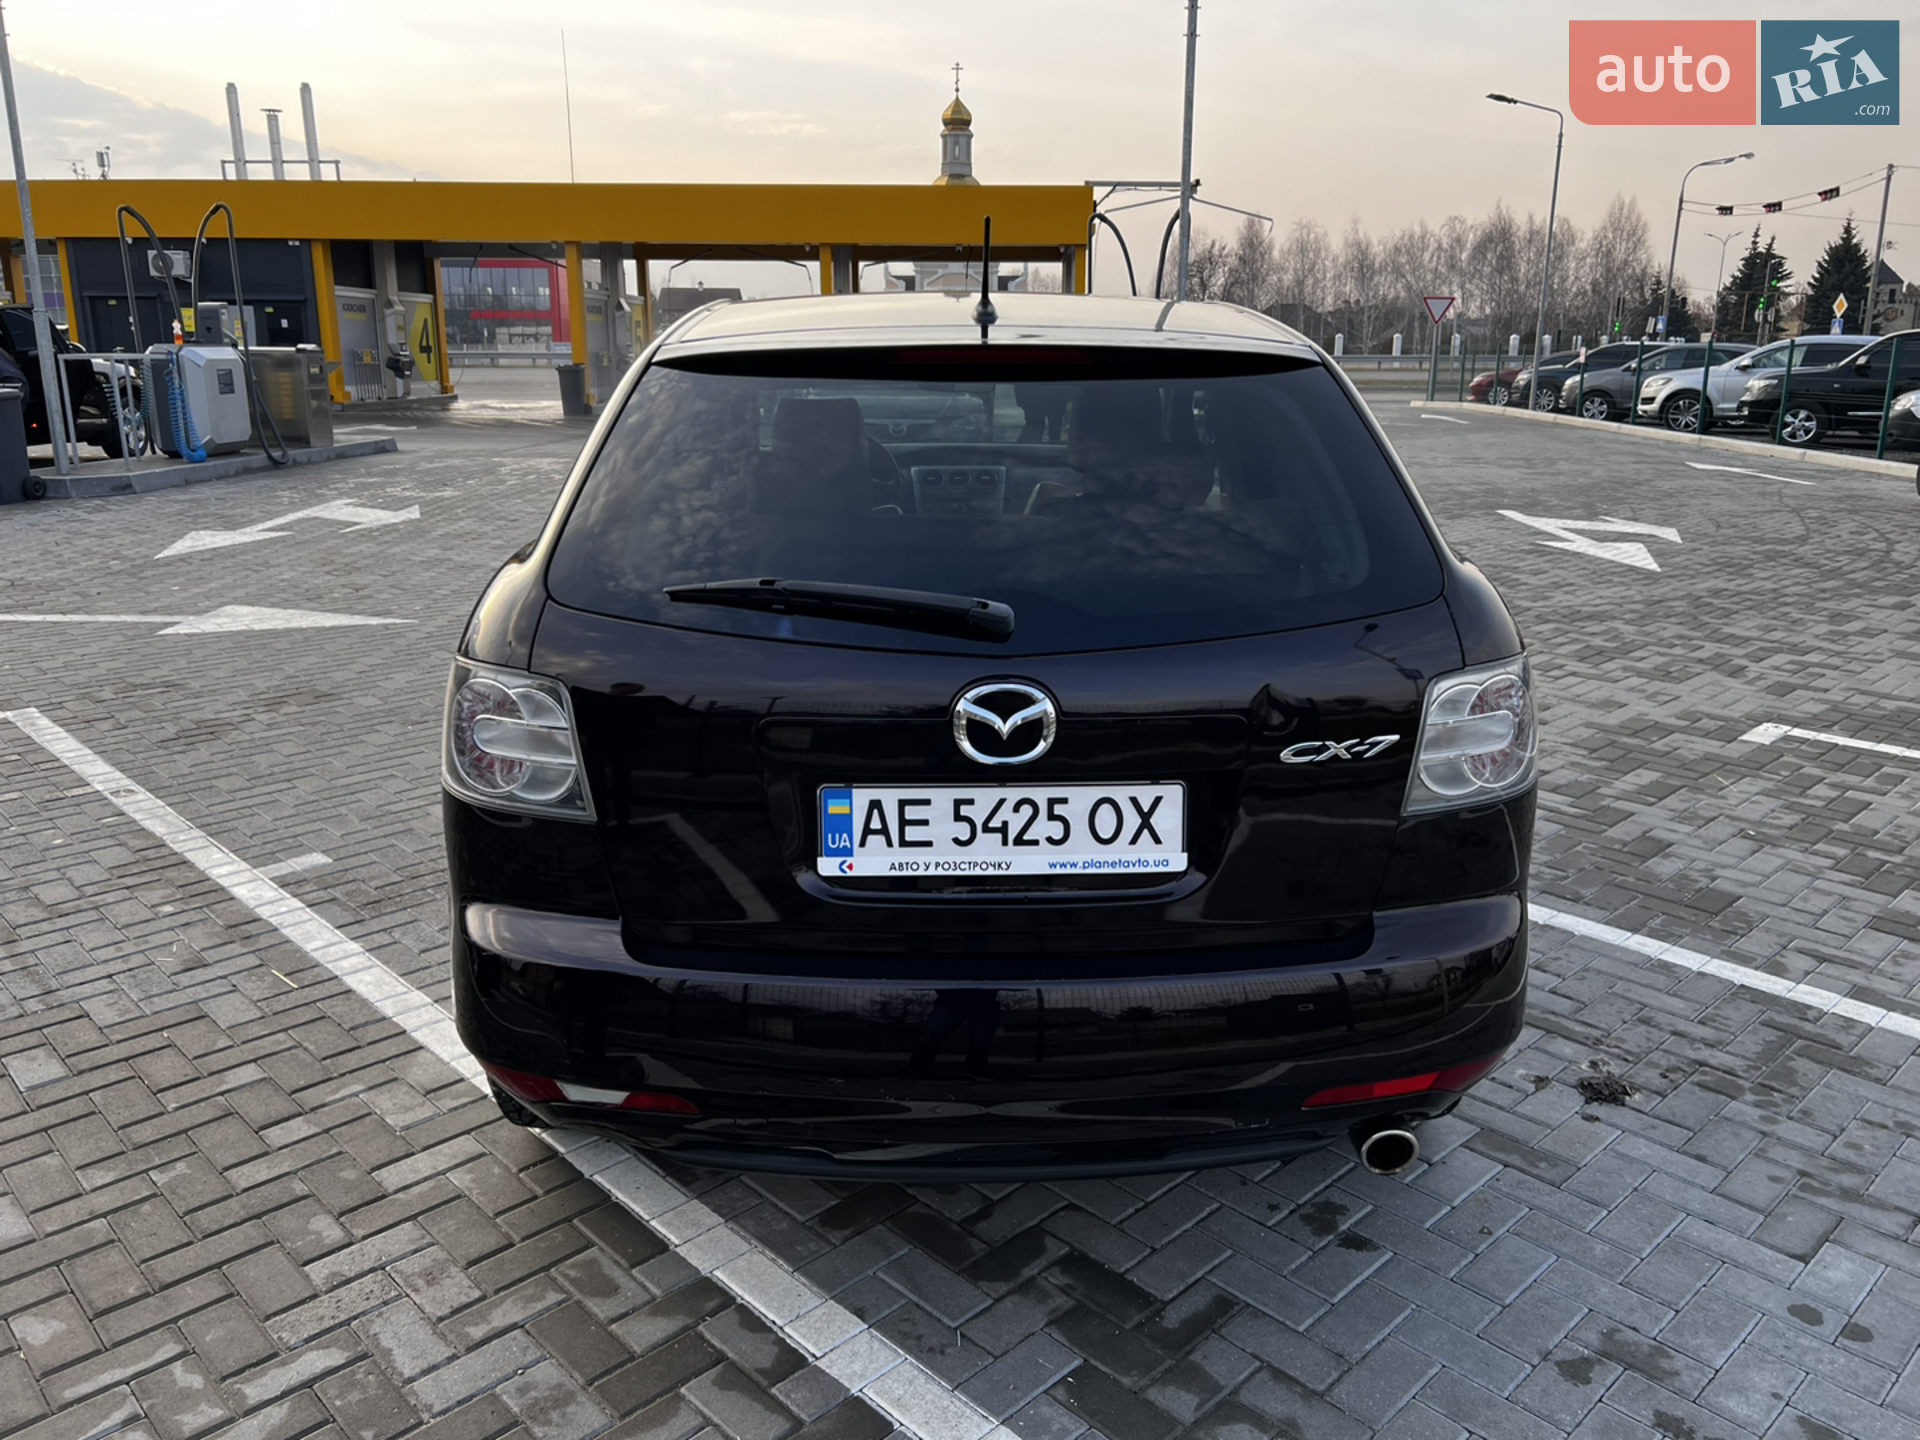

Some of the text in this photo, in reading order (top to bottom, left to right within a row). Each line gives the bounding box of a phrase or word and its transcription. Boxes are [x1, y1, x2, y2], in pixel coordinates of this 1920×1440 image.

[419, 317, 433, 365] 4
[1279, 734, 1401, 764] CX-7
[858, 795, 1164, 848] AE 5425 OX
[827, 833, 851, 849] UA
[888, 859, 1013, 872] АВТО У РОЗСТРОЧКУ
[1047, 857, 1170, 871] www.planetavto.ua
